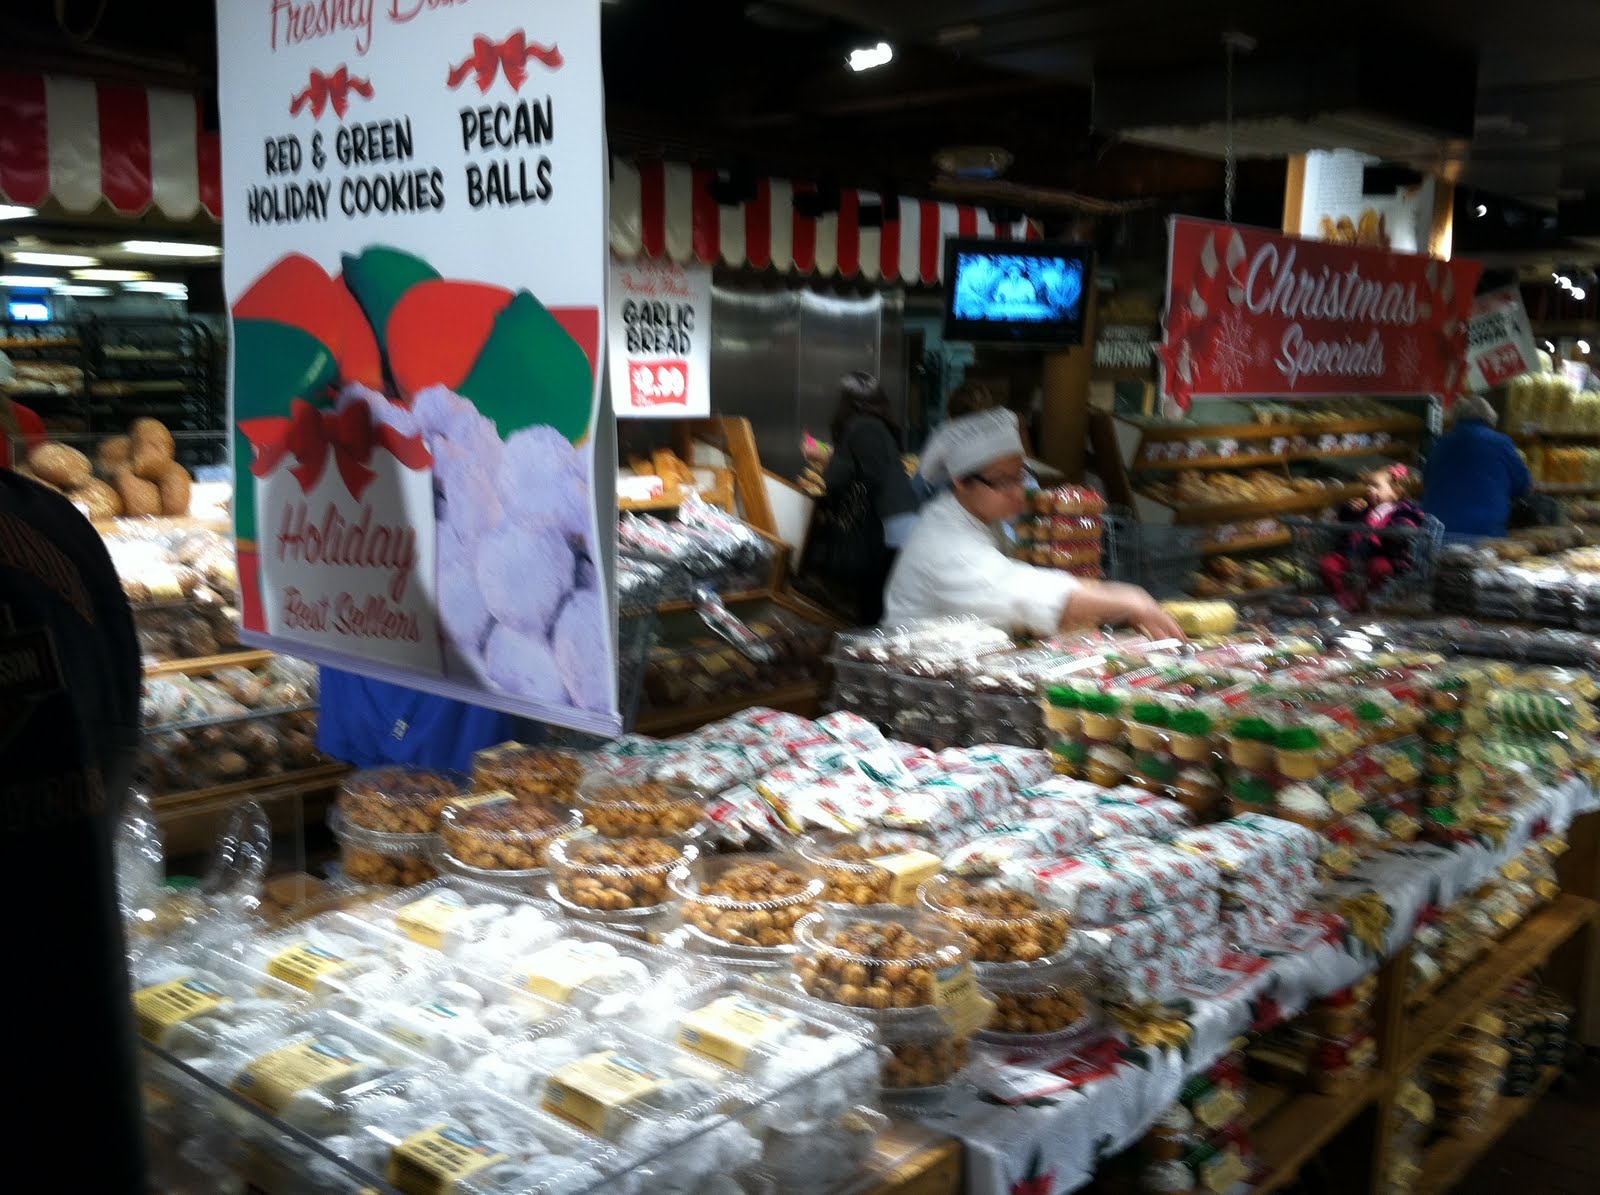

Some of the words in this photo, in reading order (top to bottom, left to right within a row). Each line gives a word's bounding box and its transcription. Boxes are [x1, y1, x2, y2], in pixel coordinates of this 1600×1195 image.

[264, 134, 303, 178] RED
[311, 129, 328, 173] &
[336, 116, 414, 168] GREEN
[460, 97, 554, 154] PECAN
[248, 177, 332, 227] HOLIDAY
[339, 166, 446, 221] COOKIES
[466, 156, 553, 209] BALLS
[1246, 242, 1419, 324] Christmas
[622, 299, 696, 332] GARLIC
[626, 326, 693, 356] BREAD
[1275, 321, 1386, 390] Specials
[276, 503, 420, 605] Holiday
[283, 587, 331, 632] Best
[334, 592, 422, 643] Sellers
